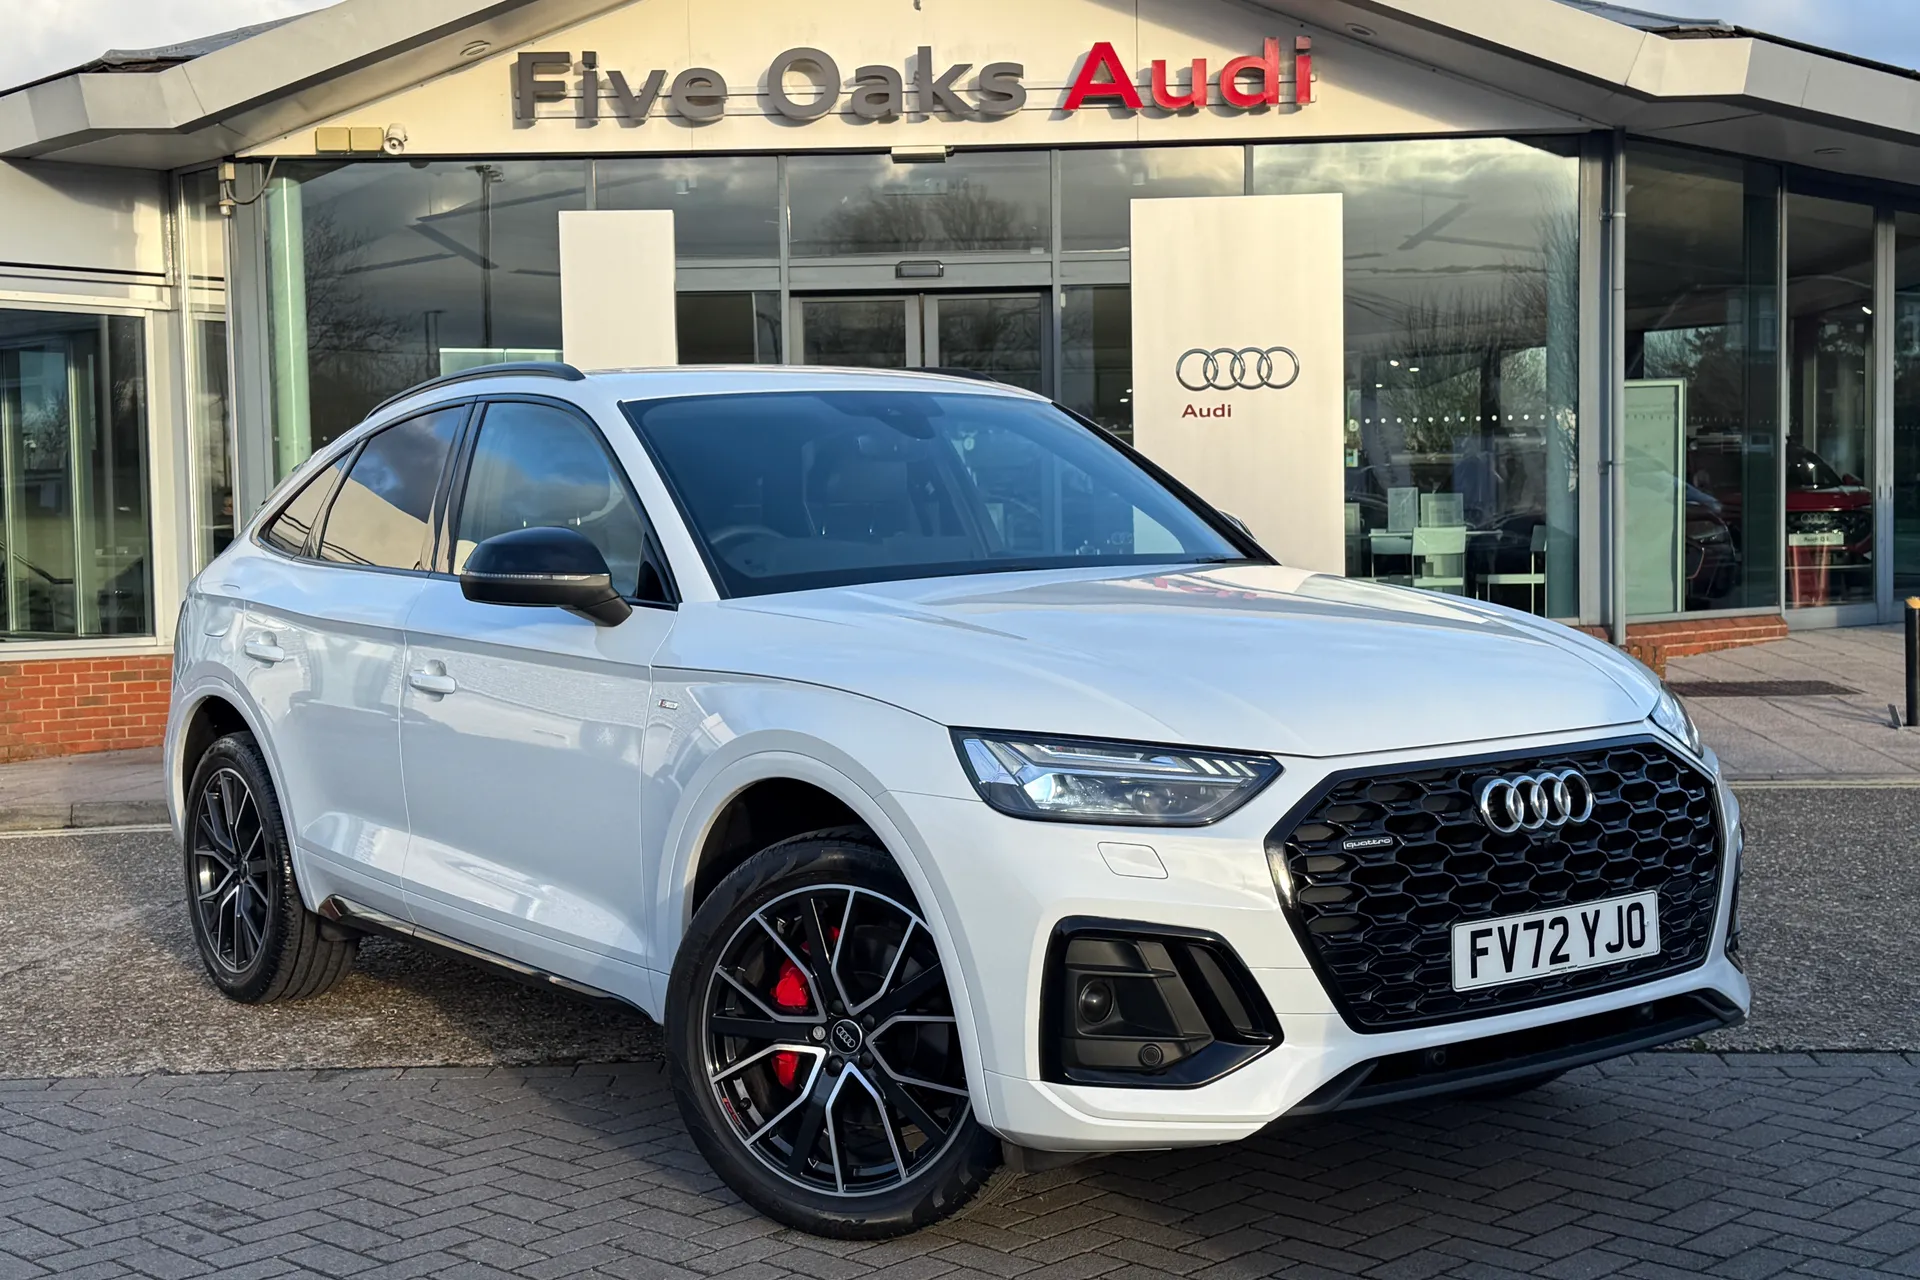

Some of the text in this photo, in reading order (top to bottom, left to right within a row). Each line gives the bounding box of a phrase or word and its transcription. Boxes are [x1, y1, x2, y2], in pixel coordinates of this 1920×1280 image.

[518, 36, 1312, 121] Five Oaks Audi
[1181, 403, 1231, 418] Audi
[1346, 838, 1391, 849] quattro
[1470, 902, 1646, 979] FV72 YJO
